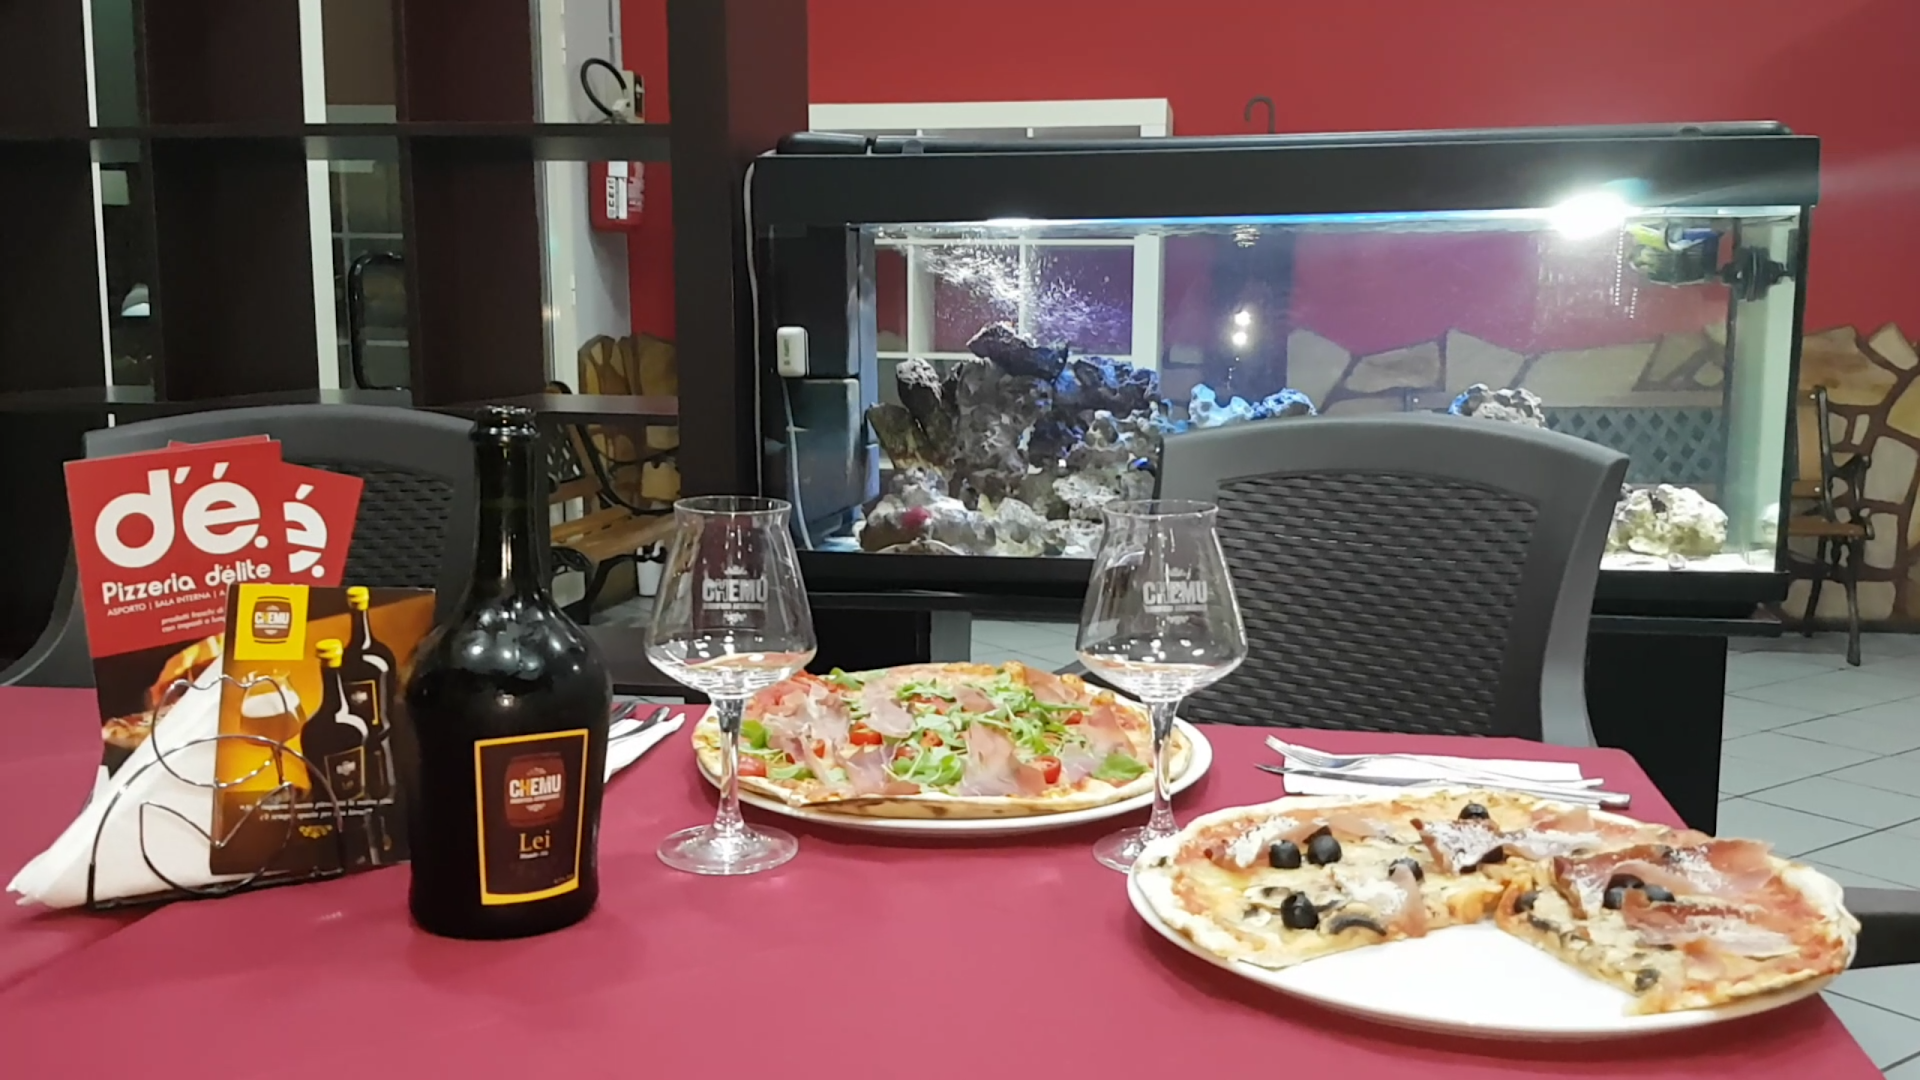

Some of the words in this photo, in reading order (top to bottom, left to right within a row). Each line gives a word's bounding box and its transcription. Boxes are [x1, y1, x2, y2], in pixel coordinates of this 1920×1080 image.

[102, 572, 197, 605] Pizzeria
[702, 578, 769, 603] CHEMU
[1142, 580, 1208, 605] CHEMU
[107, 602, 147, 616] ASPORTO
[154, 598, 175, 609] SALA
[176, 591, 212, 604] INTERNA
[254, 611, 290, 625] CHEMU
[509, 773, 562, 798] CHEMU
[519, 829, 550, 852] Lei
